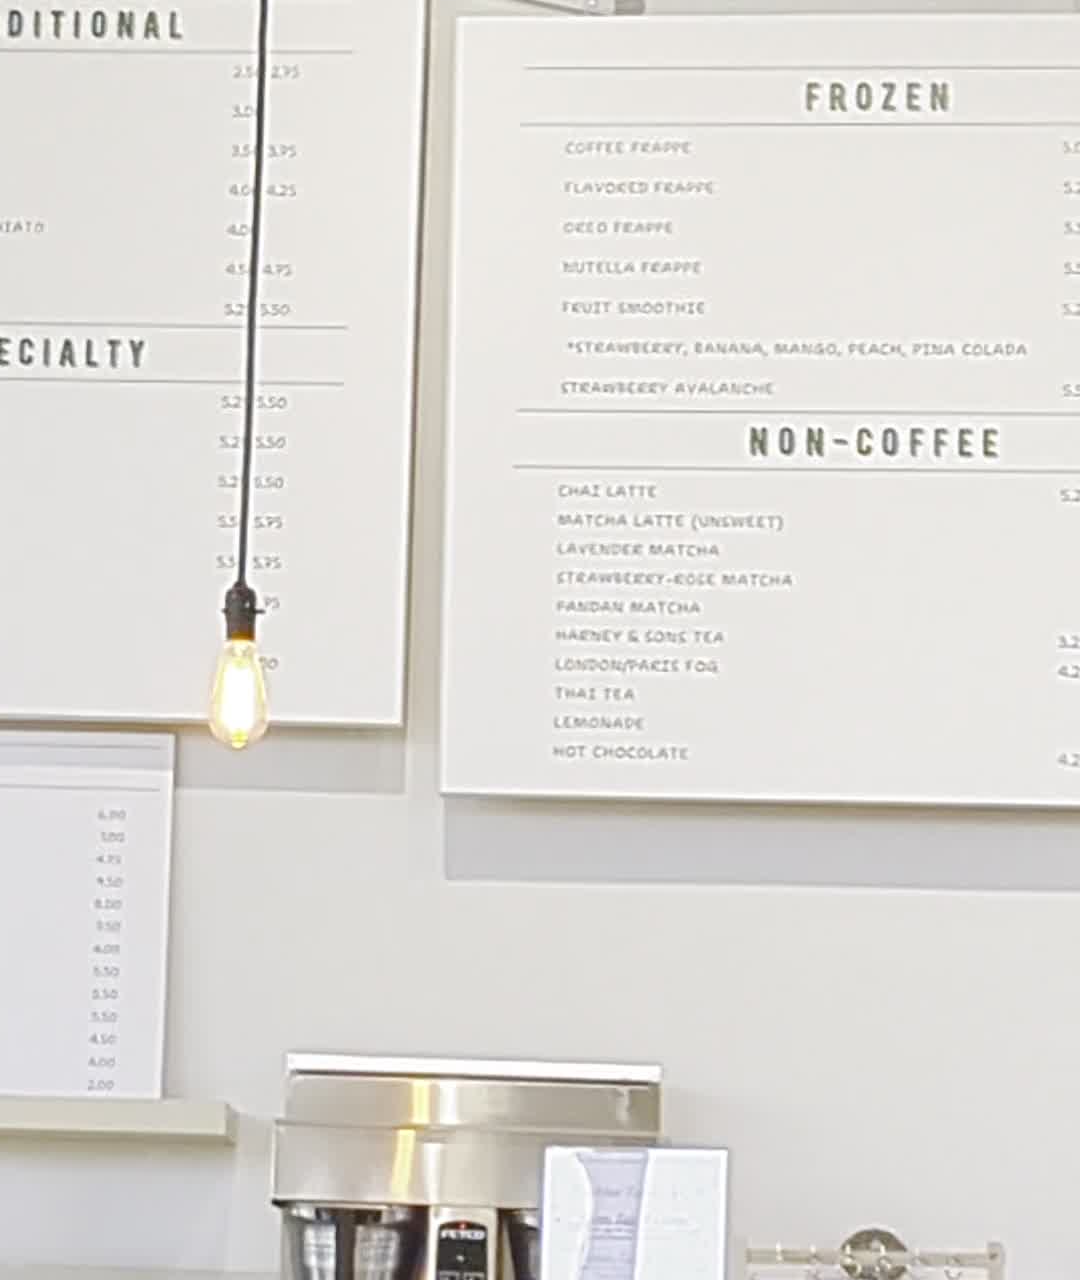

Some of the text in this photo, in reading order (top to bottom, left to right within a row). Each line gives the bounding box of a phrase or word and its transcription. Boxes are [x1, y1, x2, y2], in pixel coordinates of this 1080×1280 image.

[804, 81, 950, 113] FROZEN
[565, 141, 692, 154] COFFEE FRAPPE
[564, 181, 714, 194] FLAVORED FRAPPE
[563, 221, 673, 234] OREO FRAPPE
[563, 261, 702, 275] NUTELLA FRAPPE
[562, 301, 705, 315] FRUIT SMOOTHIE
[694, 342, 768, 357] BANANA,
[774, 343, 842, 357] MANGO,
[961, 344, 1028, 357] COLADA
[561, 381, 774, 395] STRAWBERRY AVALANCHE
[748, 425, 1000, 459] NON-COFFEE
[558, 484, 657, 498] CHAI LATTE
[557, 513, 784, 532] MATCHA LATTE (UNSWEET)
[557, 542, 720, 557] LAVENDER MATCHA
[557, 571, 793, 587] STRAWBERRY-ROSE MATCHA
[629, 601, 701, 615] MATCHA
[555, 629, 622, 642] HARNEY
[645, 631, 687, 644] SONS
[693, 631, 725, 644] TEA
[555, 658, 720, 673] LONDON/PARIS FOG
[555, 686, 635, 701] THAI TEA
[553, 716, 645, 730] LEMONADE
[552, 745, 689, 760] HOT CHOCOLATE
